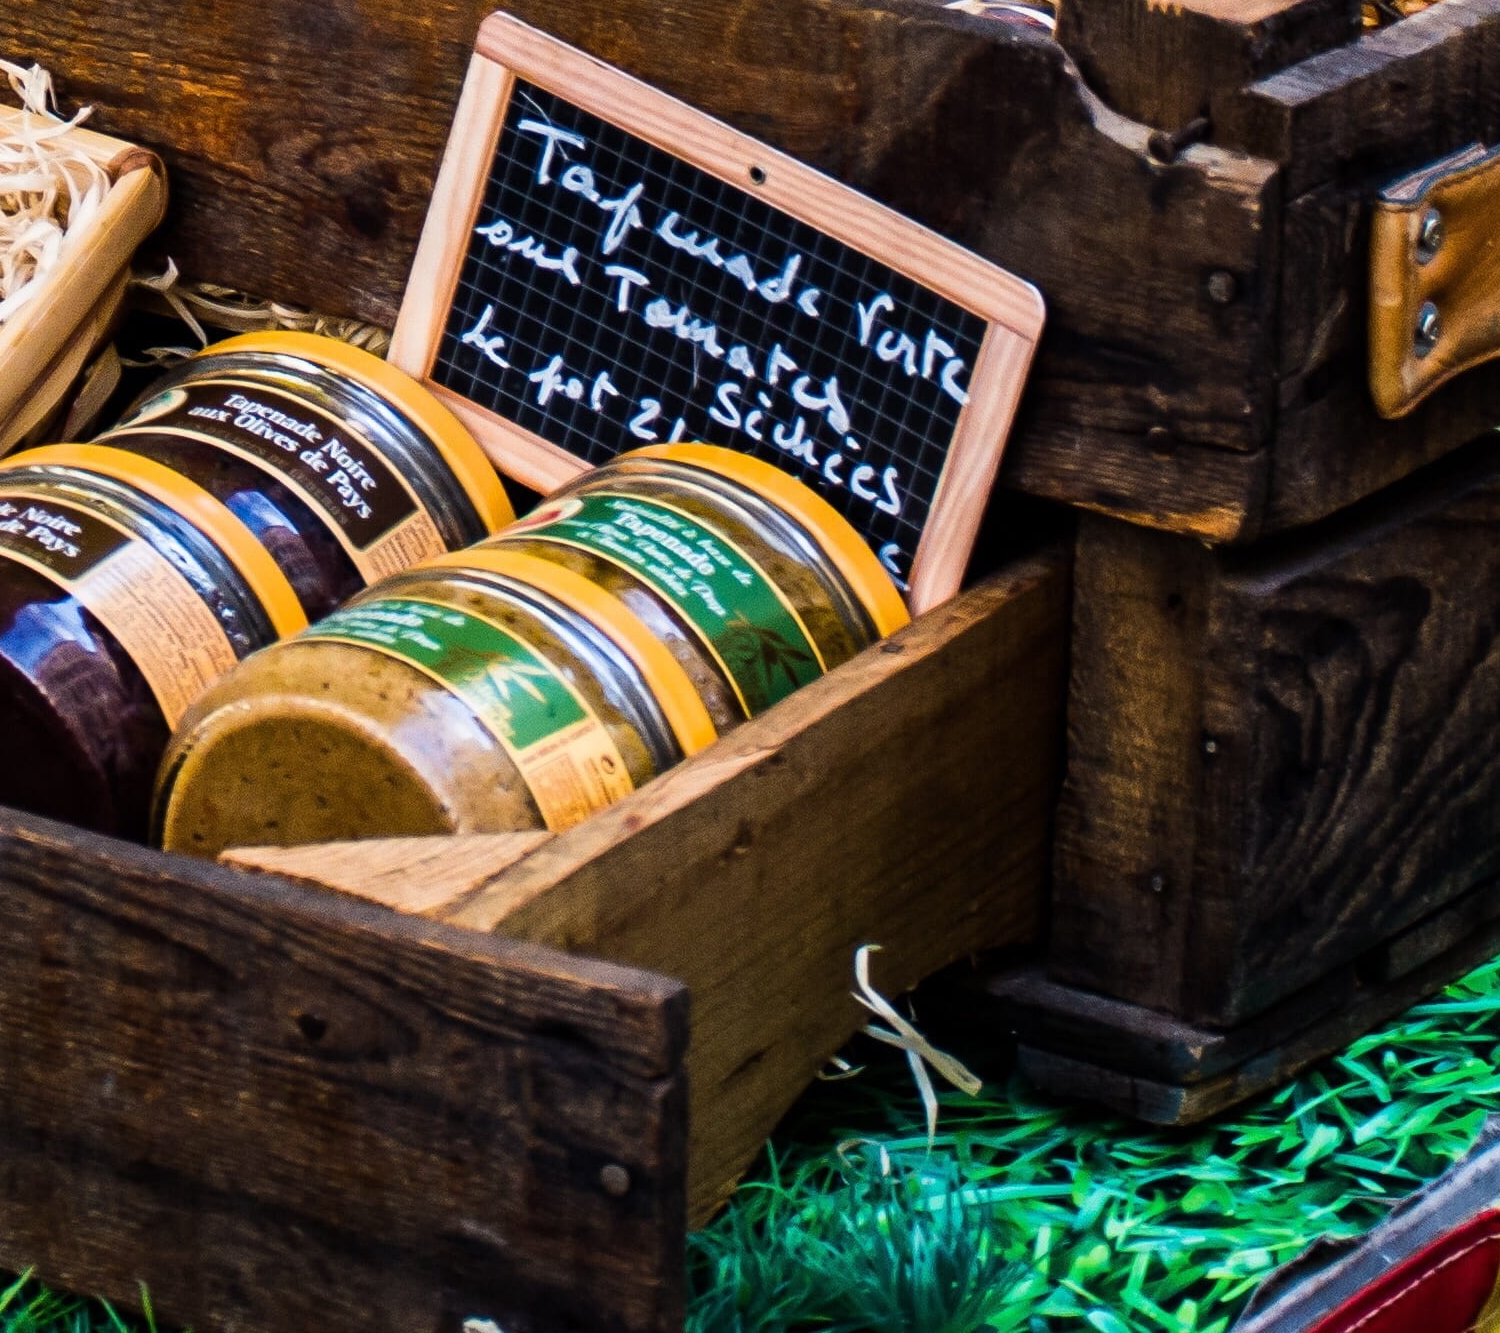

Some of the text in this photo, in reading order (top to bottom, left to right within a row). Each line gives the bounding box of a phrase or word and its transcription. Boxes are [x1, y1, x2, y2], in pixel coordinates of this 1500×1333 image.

[528, 354, 617, 411] pot
[858, 293, 971, 406] Verte
[188, 403, 373, 522] aux Olives de Pays
[224, 392, 377, 493] Tapenade Noire
